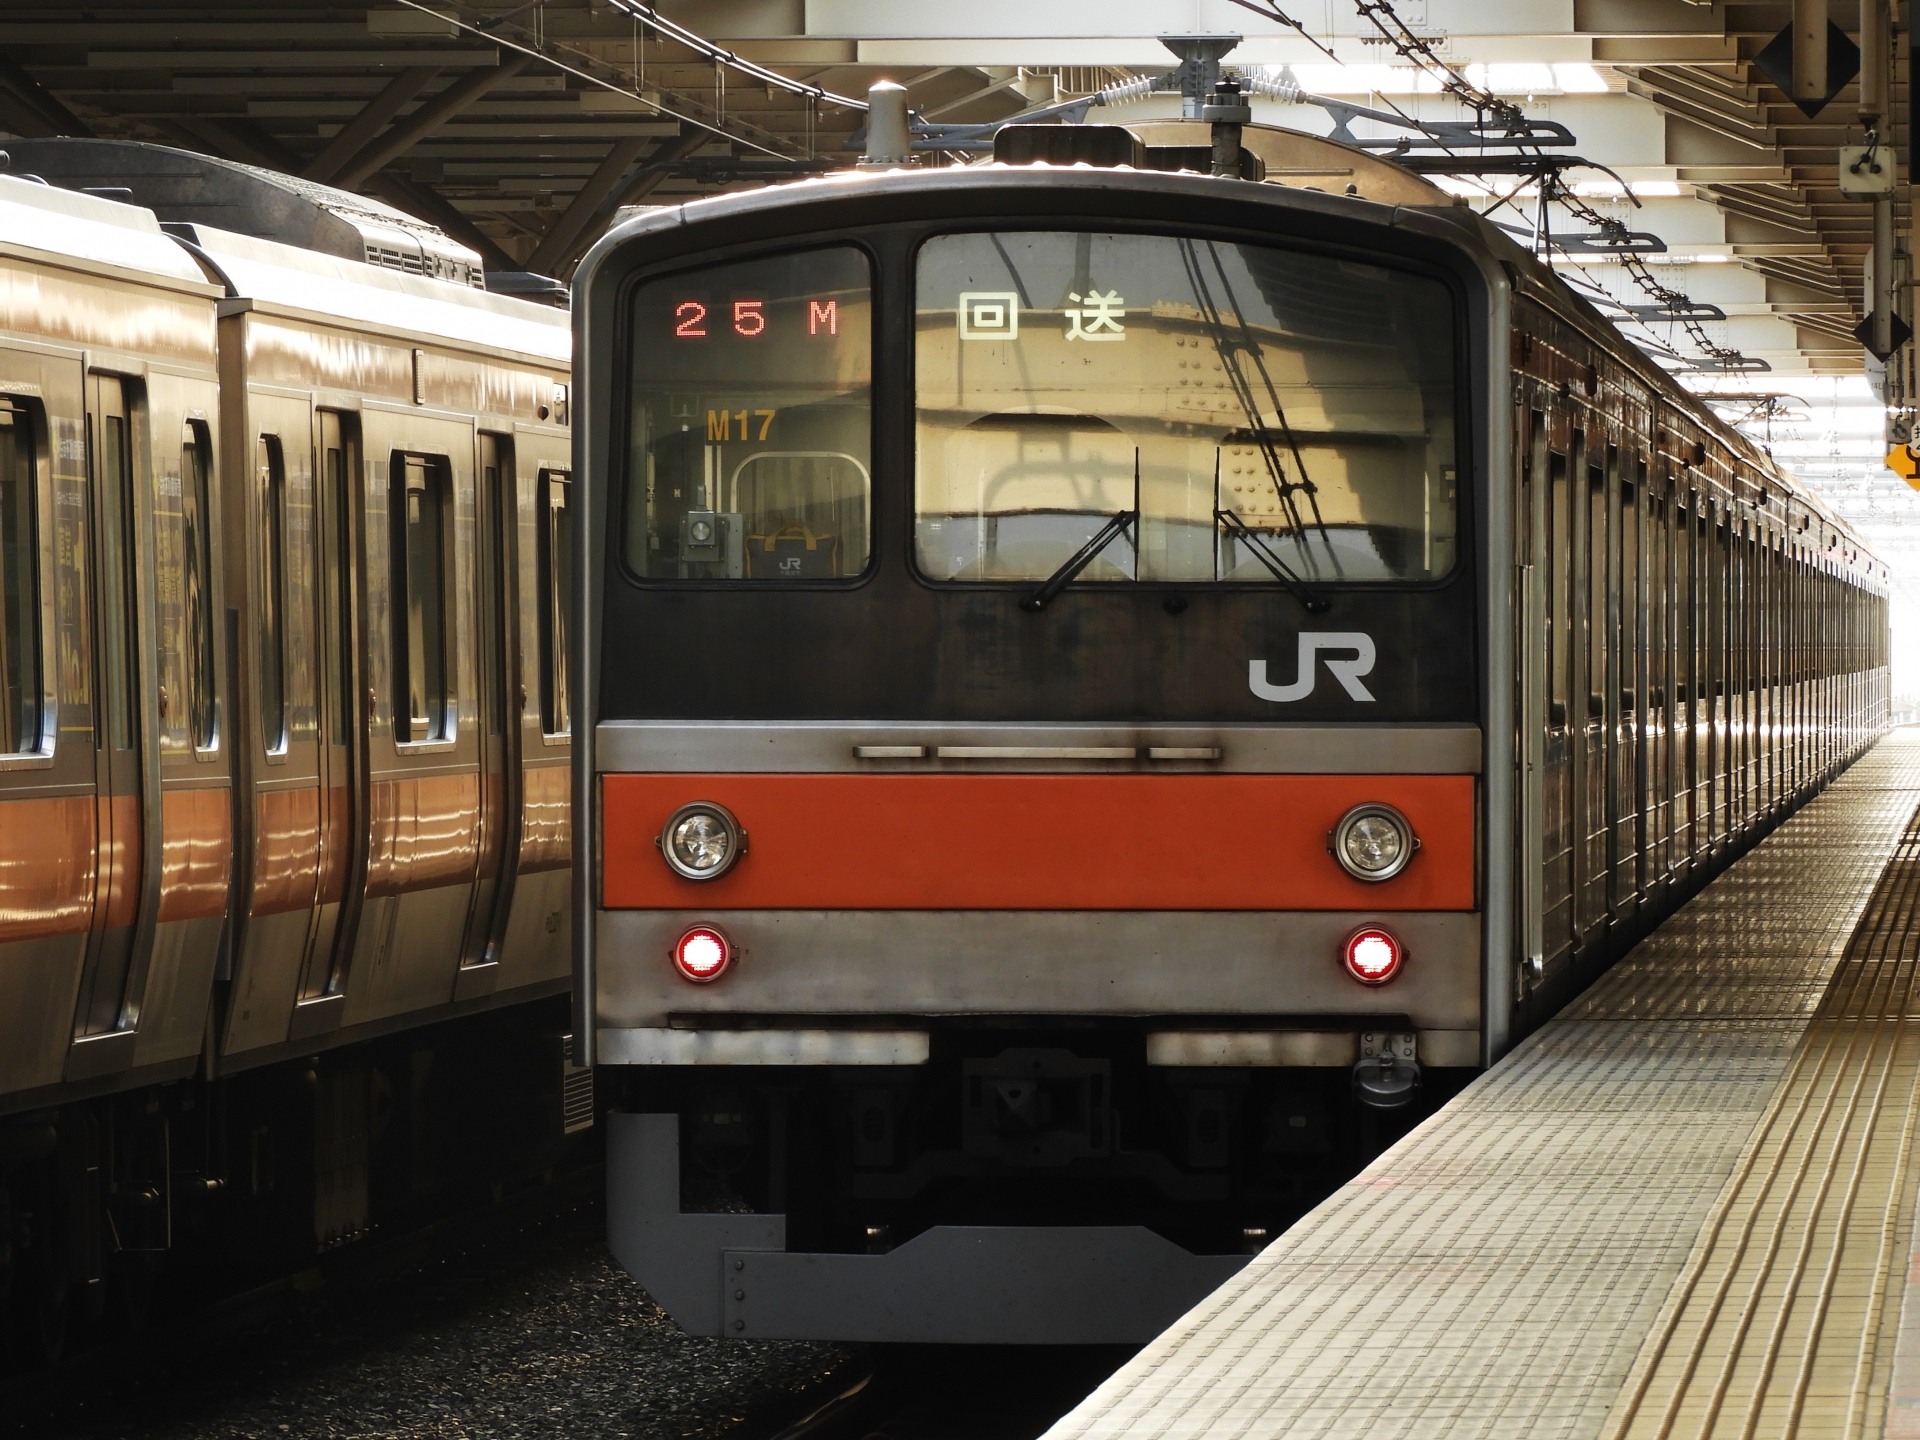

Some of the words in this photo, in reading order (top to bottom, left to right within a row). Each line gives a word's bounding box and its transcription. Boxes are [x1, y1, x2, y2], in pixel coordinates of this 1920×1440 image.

[809, 300, 837, 335] M
[959, 289, 1127, 342] 回送
[707, 409, 776, 441] M17
[779, 557, 801, 570] JR
[1248, 631, 1377, 703] JR
